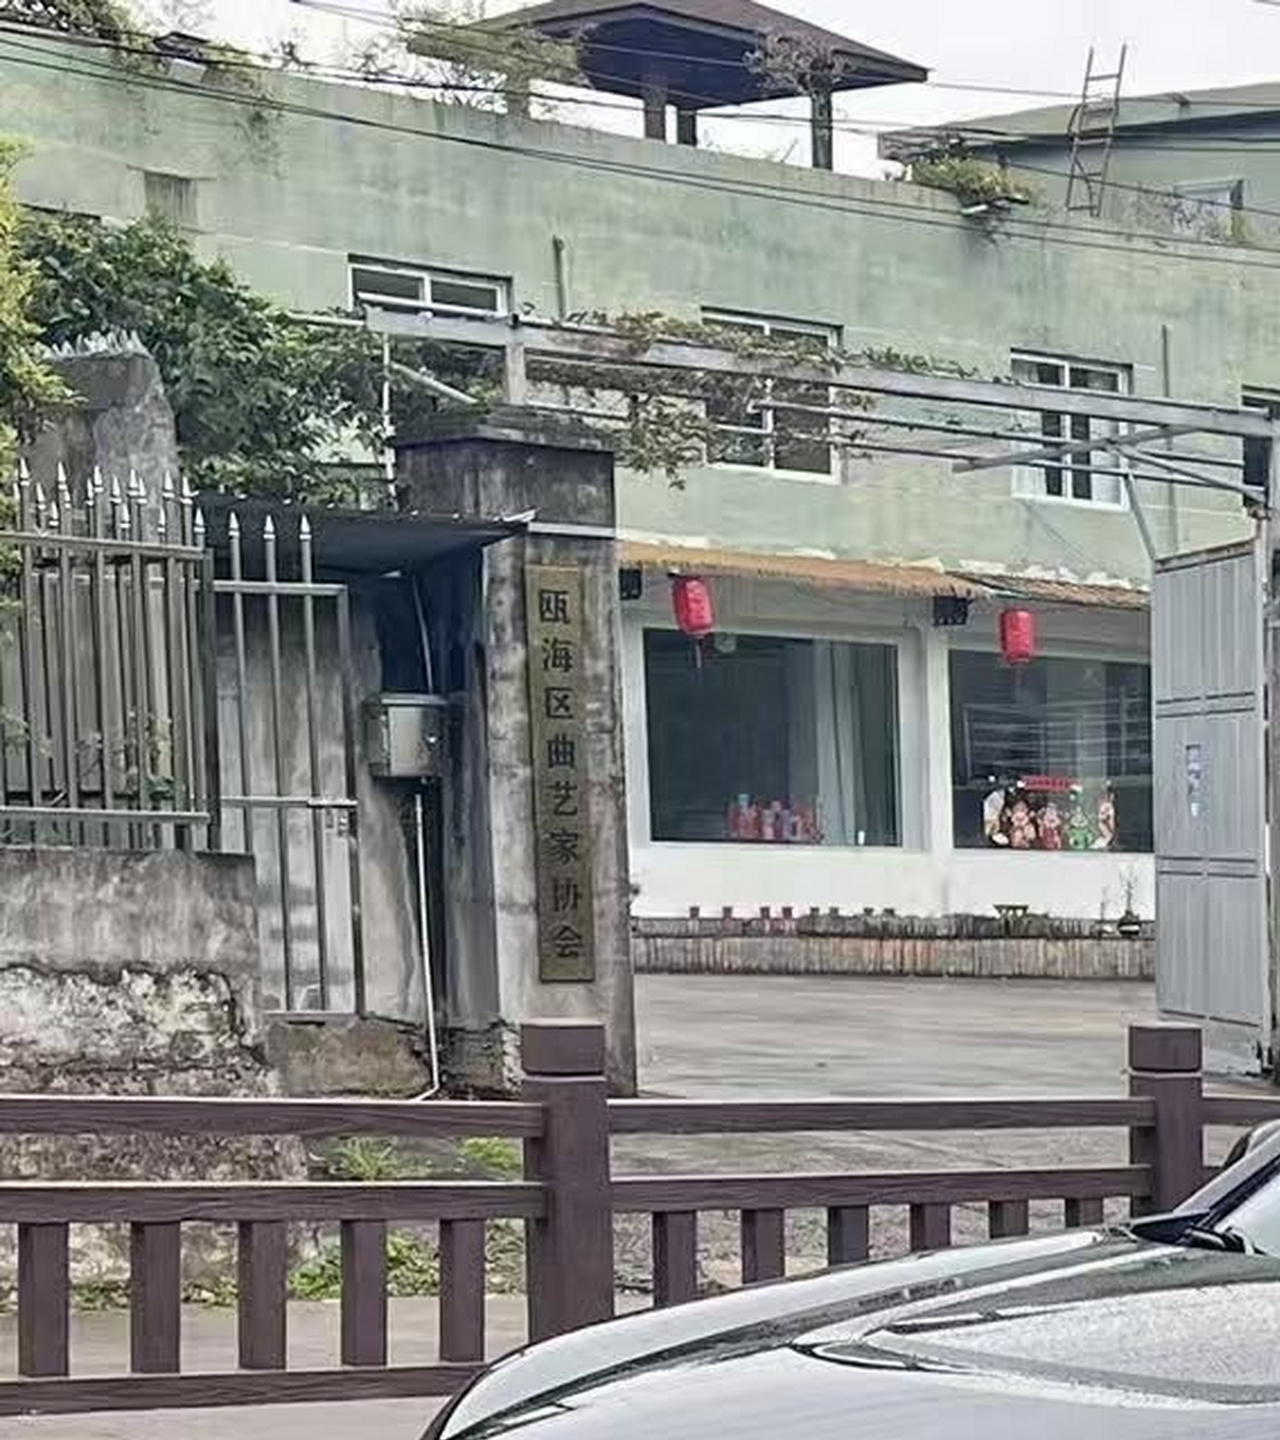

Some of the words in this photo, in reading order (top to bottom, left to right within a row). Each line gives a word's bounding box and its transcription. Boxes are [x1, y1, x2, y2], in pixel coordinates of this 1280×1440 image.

[538, 588, 583, 959] 瓯海区曲艺家协会
